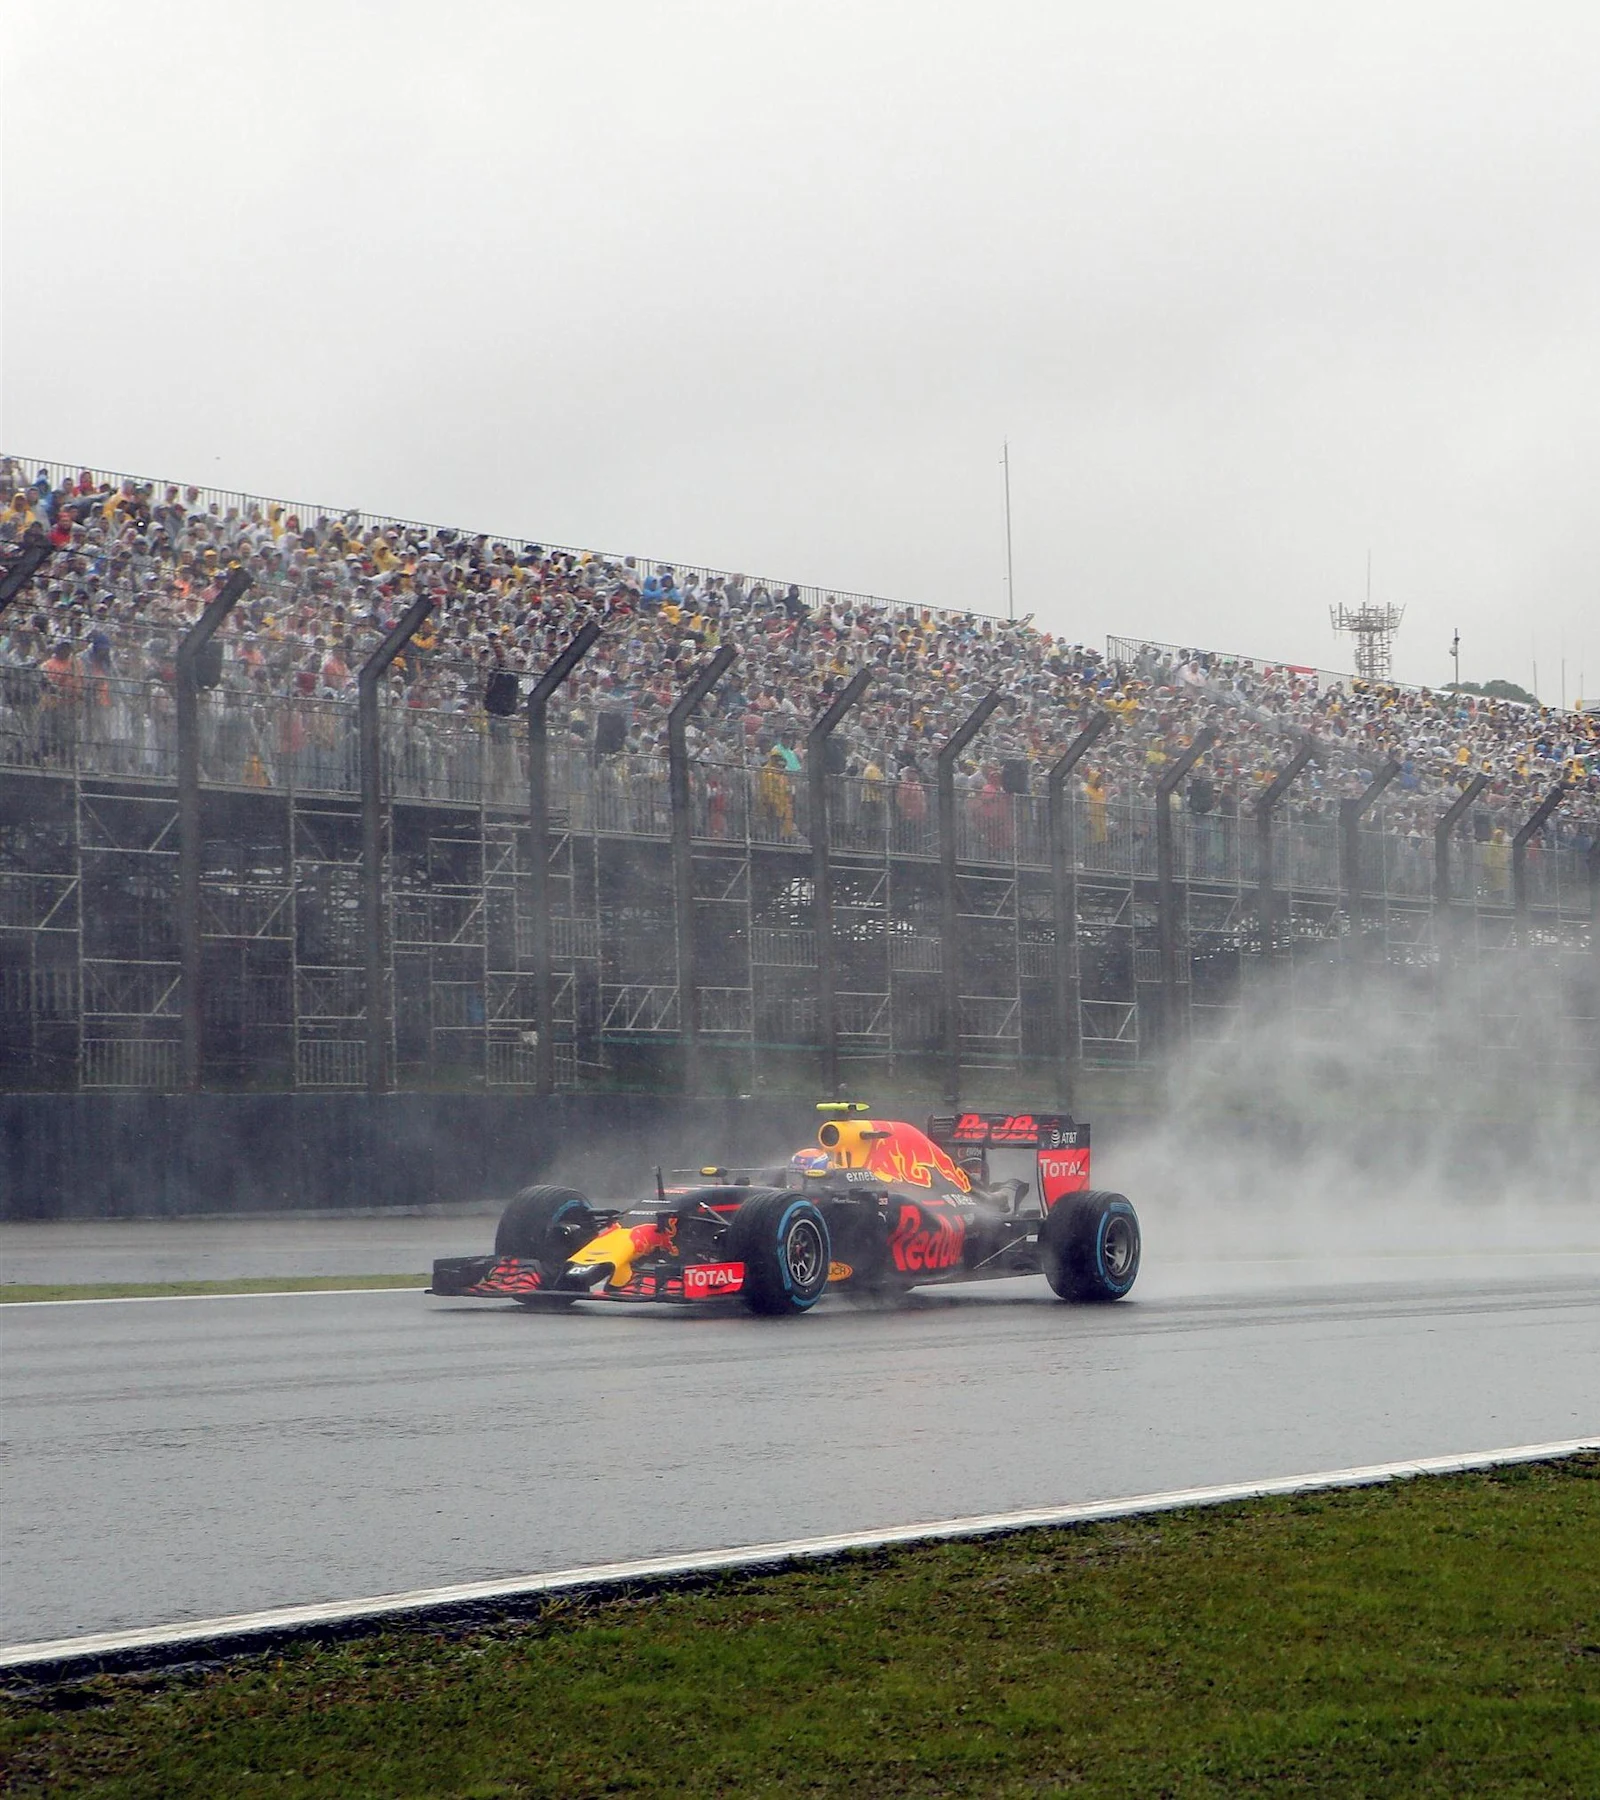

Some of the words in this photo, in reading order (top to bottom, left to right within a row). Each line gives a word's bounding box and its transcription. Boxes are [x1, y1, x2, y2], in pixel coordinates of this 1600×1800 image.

[1060, 1131, 1077, 1144] AT&T
[846, 1170, 878, 1182] exnes
[1039, 1158, 1087, 1178] TOTAL
[685, 1268, 744, 1287] TOTAL
